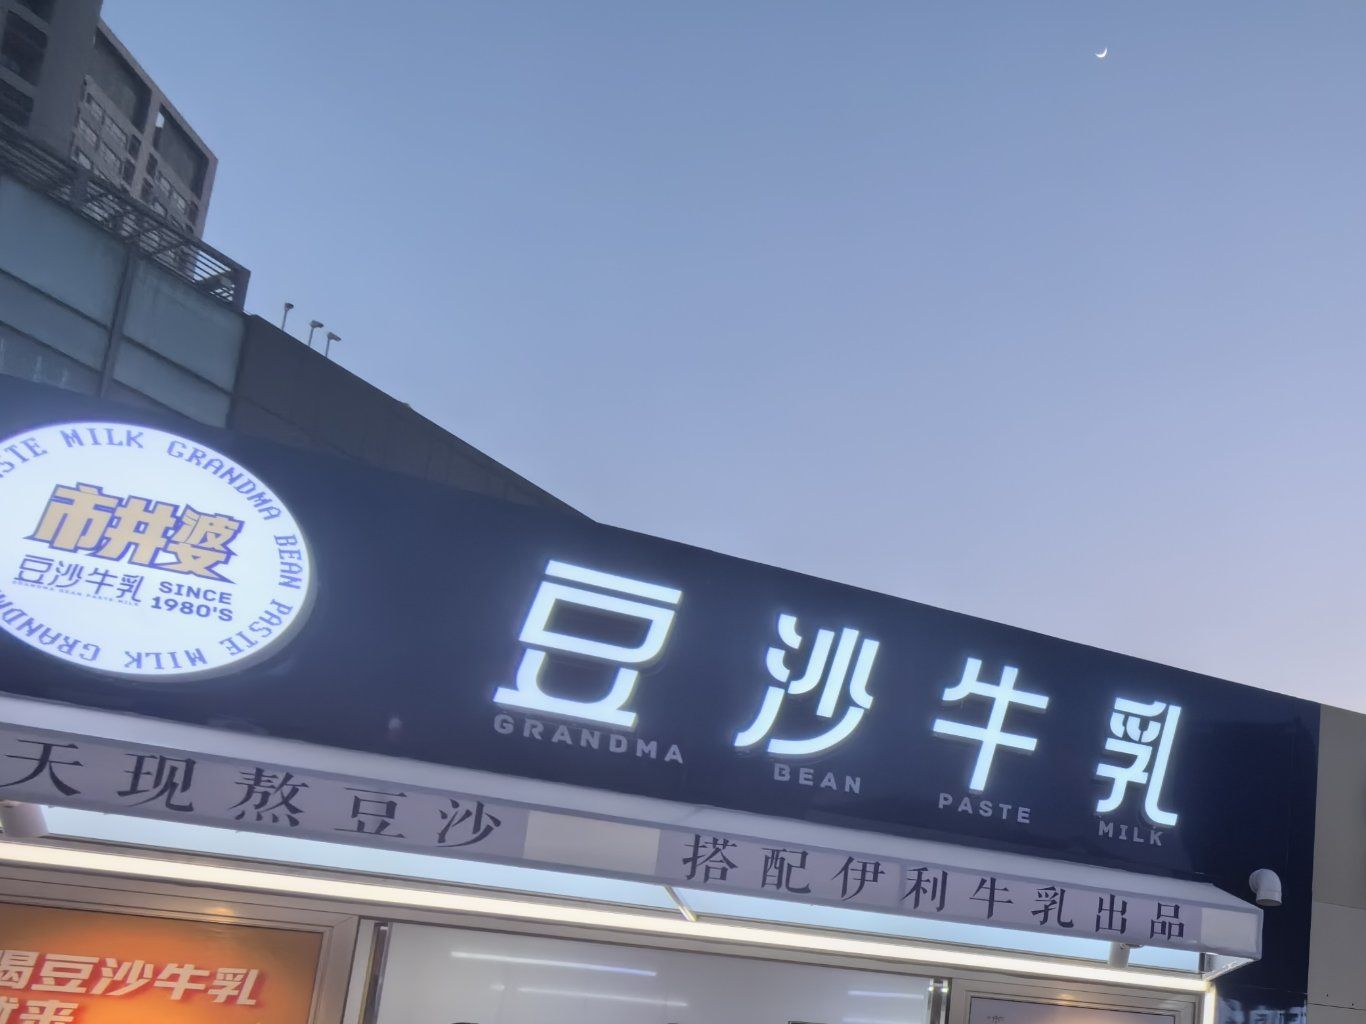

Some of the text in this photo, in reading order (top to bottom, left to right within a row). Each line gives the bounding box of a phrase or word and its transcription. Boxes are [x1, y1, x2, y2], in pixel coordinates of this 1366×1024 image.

[0, 437, 48, 479] STE
[60, 427, 145, 450] MILK
[166, 439, 282, 521] GRANDMA
[24, 482, 246, 584] 市井婆
[13, 554, 145, 603] 豆沙牛乳
[274, 534, 304, 590] BEAN
[151, 596, 234, 622] 1980'S
[158, 581, 233, 604] SINCE
[219, 598, 293, 657] PASTE
[124, 648, 208, 671] MILK
[492, 559, 1183, 827] 豆沙牛乳
[492, 714, 1166, 848] GRANDMA BEAN PASTE MILK
[0, 737, 1185, 943] 天现熬豆沙 搭配伊利牛乳出品
